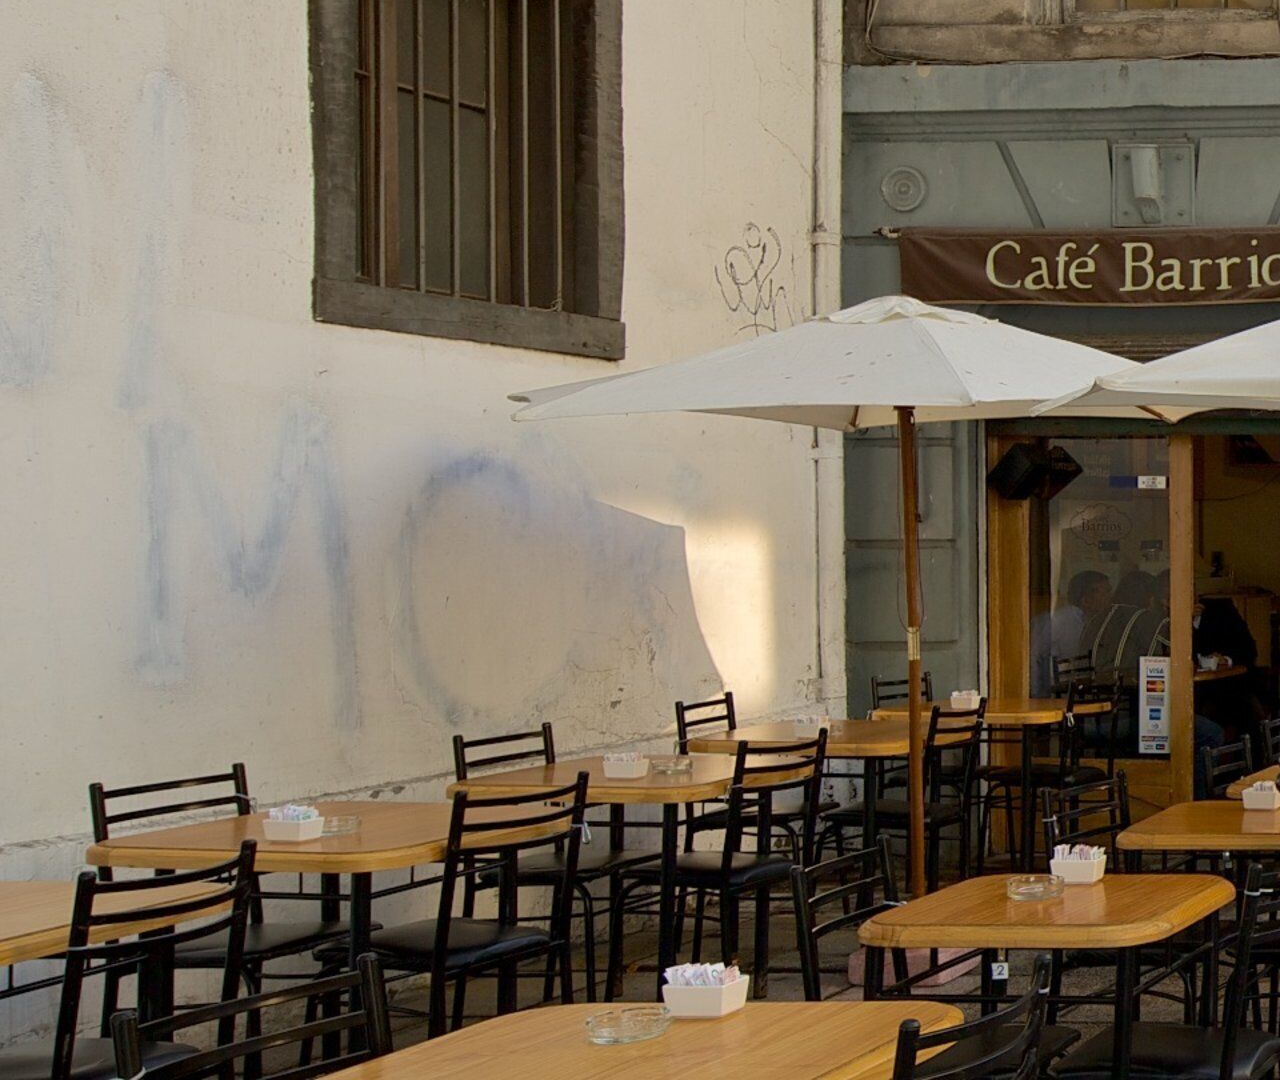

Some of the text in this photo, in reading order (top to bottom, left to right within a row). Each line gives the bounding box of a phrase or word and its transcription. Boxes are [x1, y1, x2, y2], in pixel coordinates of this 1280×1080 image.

[985, 240, 1099, 291] Café
[1082, 520, 1122, 533] Barrios
[996, 964, 1005, 976] 2
